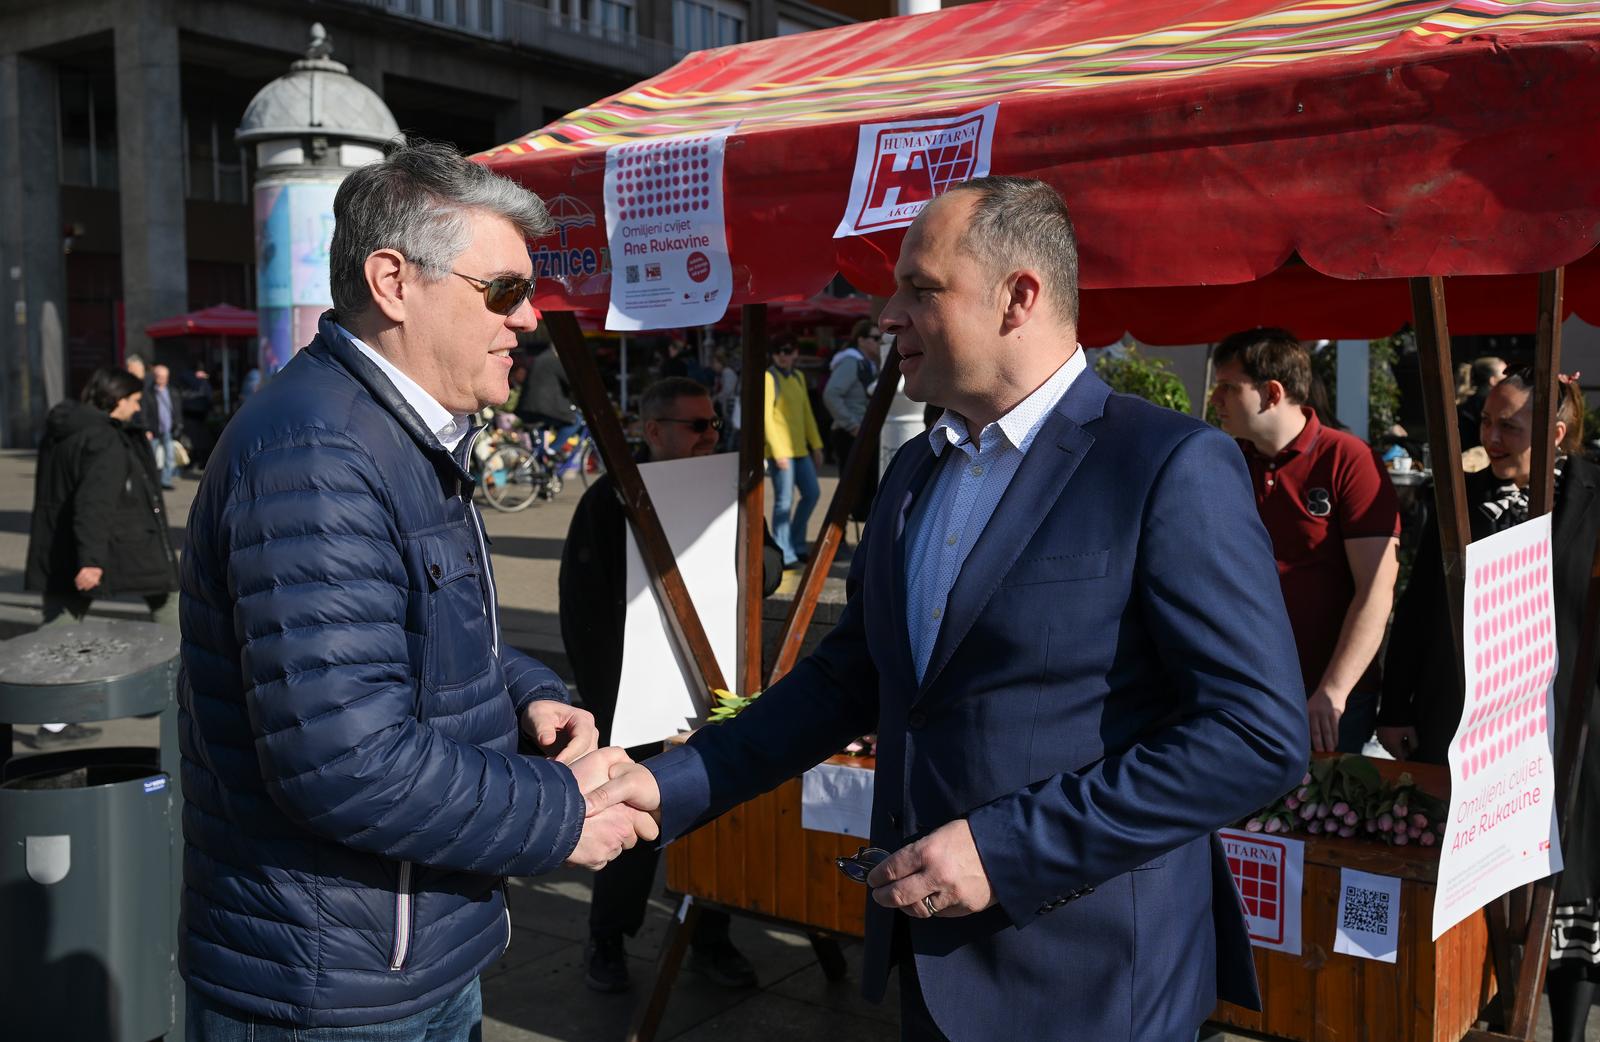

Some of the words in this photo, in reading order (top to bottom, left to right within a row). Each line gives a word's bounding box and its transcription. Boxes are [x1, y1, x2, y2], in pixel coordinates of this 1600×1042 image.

[883, 125, 976, 150] HUMANITARNA
[886, 203, 925, 217] AKCIJ
[622, 223, 662, 238] Omiljeni
[664, 219, 691, 234] cvijet
[624, 242, 647, 256] Ane
[649, 234, 710, 253] Rukavine
[1457, 774, 1506, 824] Omiljeni
[1509, 756, 1543, 791] cvijet
[1452, 825, 1476, 855] Ane
[1479, 787, 1541, 836] Rukavine
